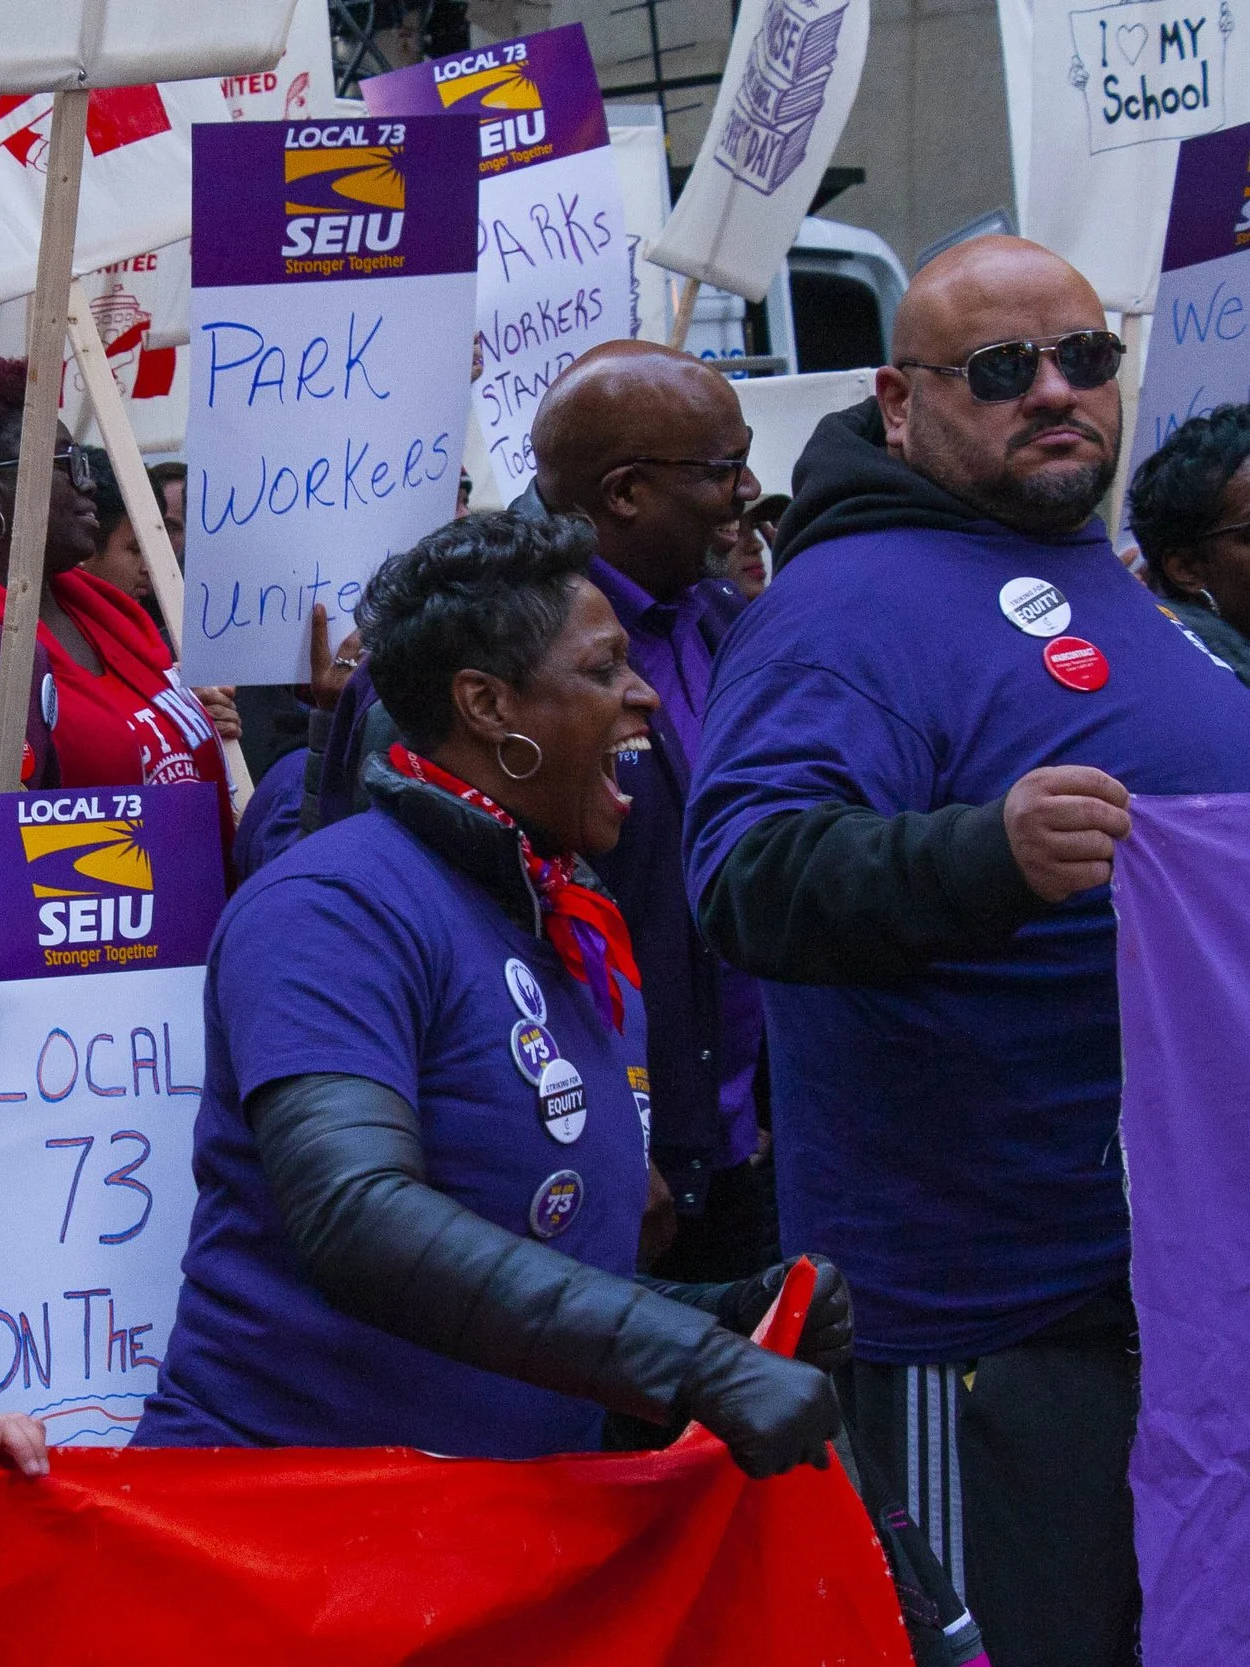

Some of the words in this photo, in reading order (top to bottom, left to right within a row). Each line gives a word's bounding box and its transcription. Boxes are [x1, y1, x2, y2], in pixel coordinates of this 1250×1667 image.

[1099, 20, 1108, 67] I
[1160, 17, 1206, 64] MY
[433, 52, 499, 83] LOCAL
[502, 43, 527, 63] 73
[1103, 60, 1210, 124] School
[285, 125, 369, 148] LOCAL
[378, 124, 406, 145] 73
[479, 109, 546, 157] EIU
[479, 155, 510, 172] onger
[510, 144, 553, 163] Together
[281, 212, 405, 257] SEIU
[285, 258, 345, 276] Stronger
[348, 254, 405, 273] Together
[201, 311, 390, 409] PARK
[18, 797, 105, 823] LOCAL
[112, 795, 142, 818] 73
[38, 894, 154, 946] SEIU
[44, 948, 101, 967] Stronger
[103, 943, 158, 964] Together
[523, 1037, 550, 1064] 73
[546, 1079, 570, 1093] STRIKING
[569, 1076, 579, 1085] FOR
[547, 1090, 583, 1116] EQUITY
[45, 1130, 153, 1245] 73
[546, 1193, 574, 1215] 73
